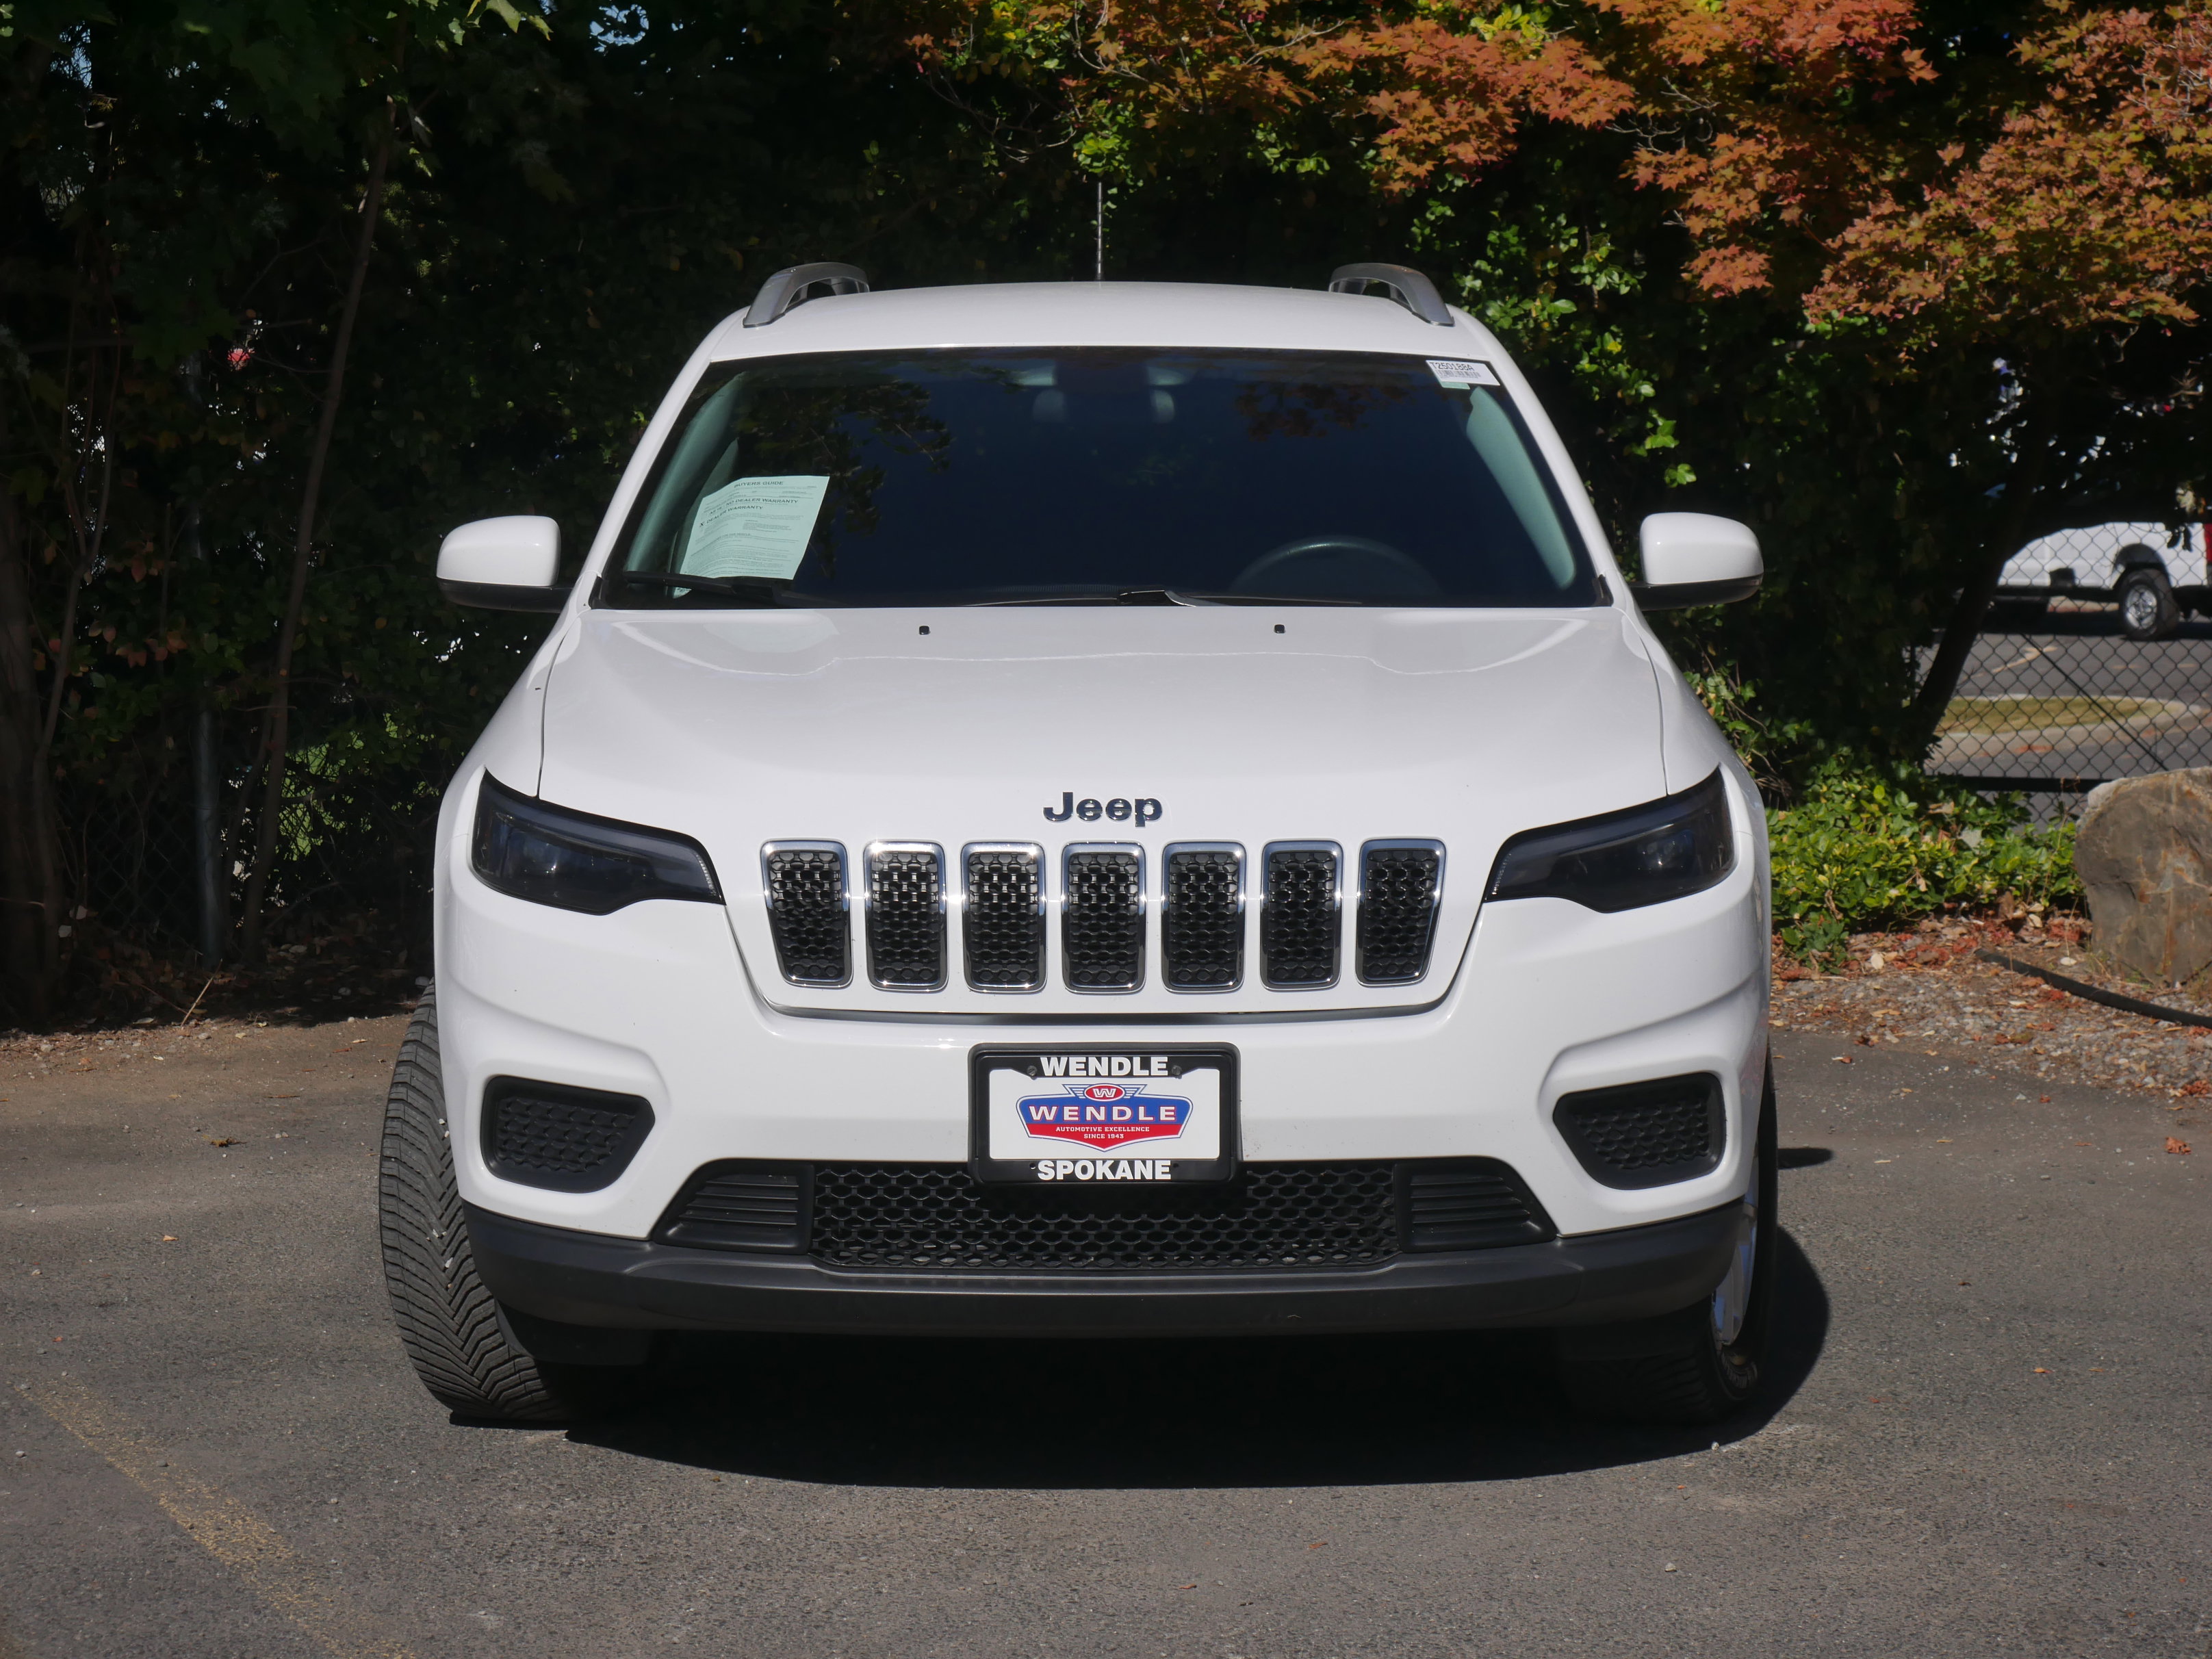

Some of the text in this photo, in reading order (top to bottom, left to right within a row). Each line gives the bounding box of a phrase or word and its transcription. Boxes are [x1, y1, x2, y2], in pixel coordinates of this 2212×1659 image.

[1042, 791, 1163, 827] Jeep
[1040, 1056, 1168, 1077] WENDLE
[1028, 1105, 1176, 1121] WENDLE
[1038, 1159, 1171, 1181] SPOKANE
